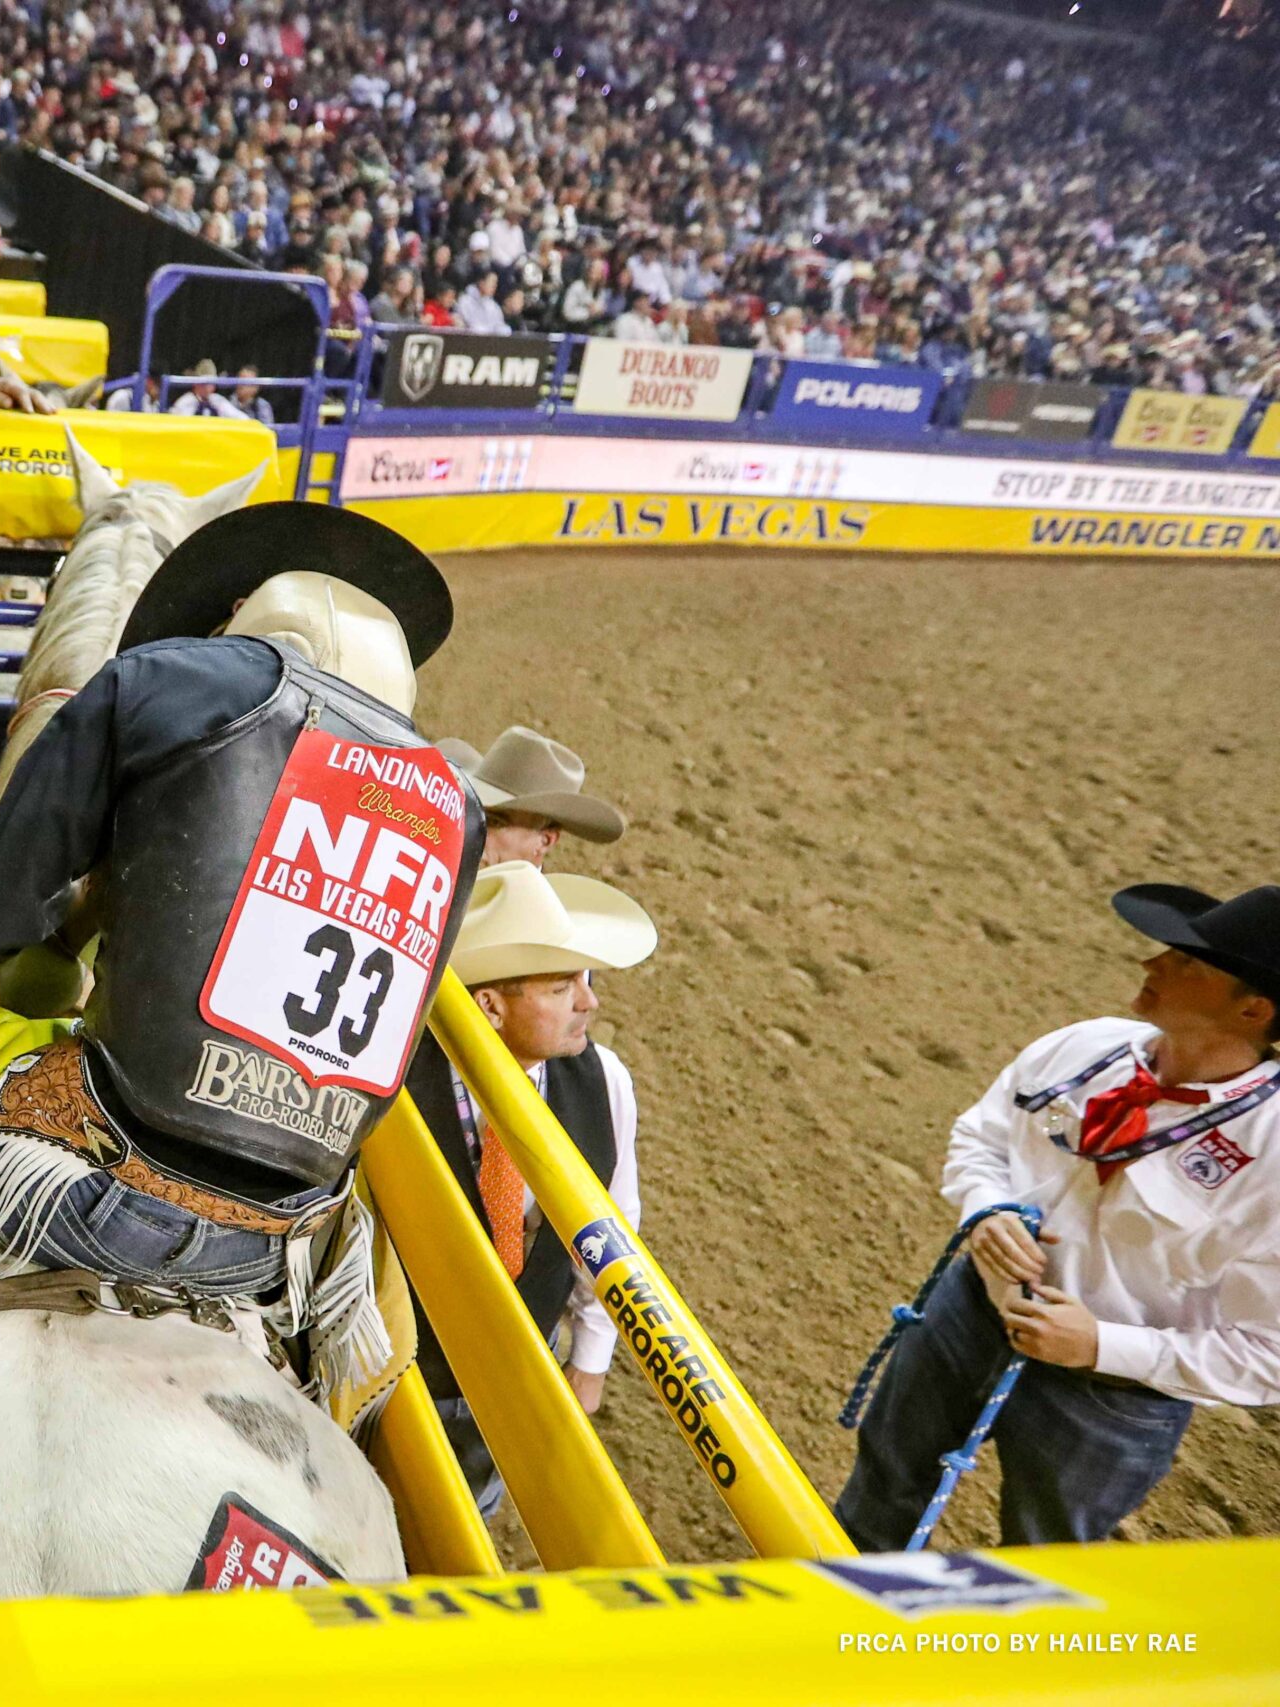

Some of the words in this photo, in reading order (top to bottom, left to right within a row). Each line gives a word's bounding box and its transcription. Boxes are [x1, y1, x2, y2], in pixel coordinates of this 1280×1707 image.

[442, 354, 540, 387] RAM
[619, 348, 721, 381] DURANGO
[627, 382, 700, 411] BOOTS
[793, 377, 923, 414] POLARIS
[29, 447, 70, 462] ARE
[993, 471, 1065, 498] STOP
[1068, 475, 1105, 500] BY
[1108, 476, 1161, 502] THE
[554, 500, 669, 539] LAS
[688, 501, 871, 541] VEGAS
[1029, 516, 1247, 549] WRANGLER
[358, 782, 442, 845] Wrangler
[271, 796, 451, 934] NFR
[253, 856, 314, 902] LAS
[322, 880, 401, 942] VEGAS
[399, 918, 438, 968] 2022
[282, 923, 394, 1059] 33
[288, 1037, 350, 1071] PRORODEO
[236, 1092, 325, 1138] PRO-RODEO
[622, 1269, 673, 1330] WE
[656, 1334, 727, 1409] ARE
[604, 1282, 738, 1490] PRORODEO
[300, 1584, 542, 1628] ARE
[575, 1572, 796, 1611] WE
